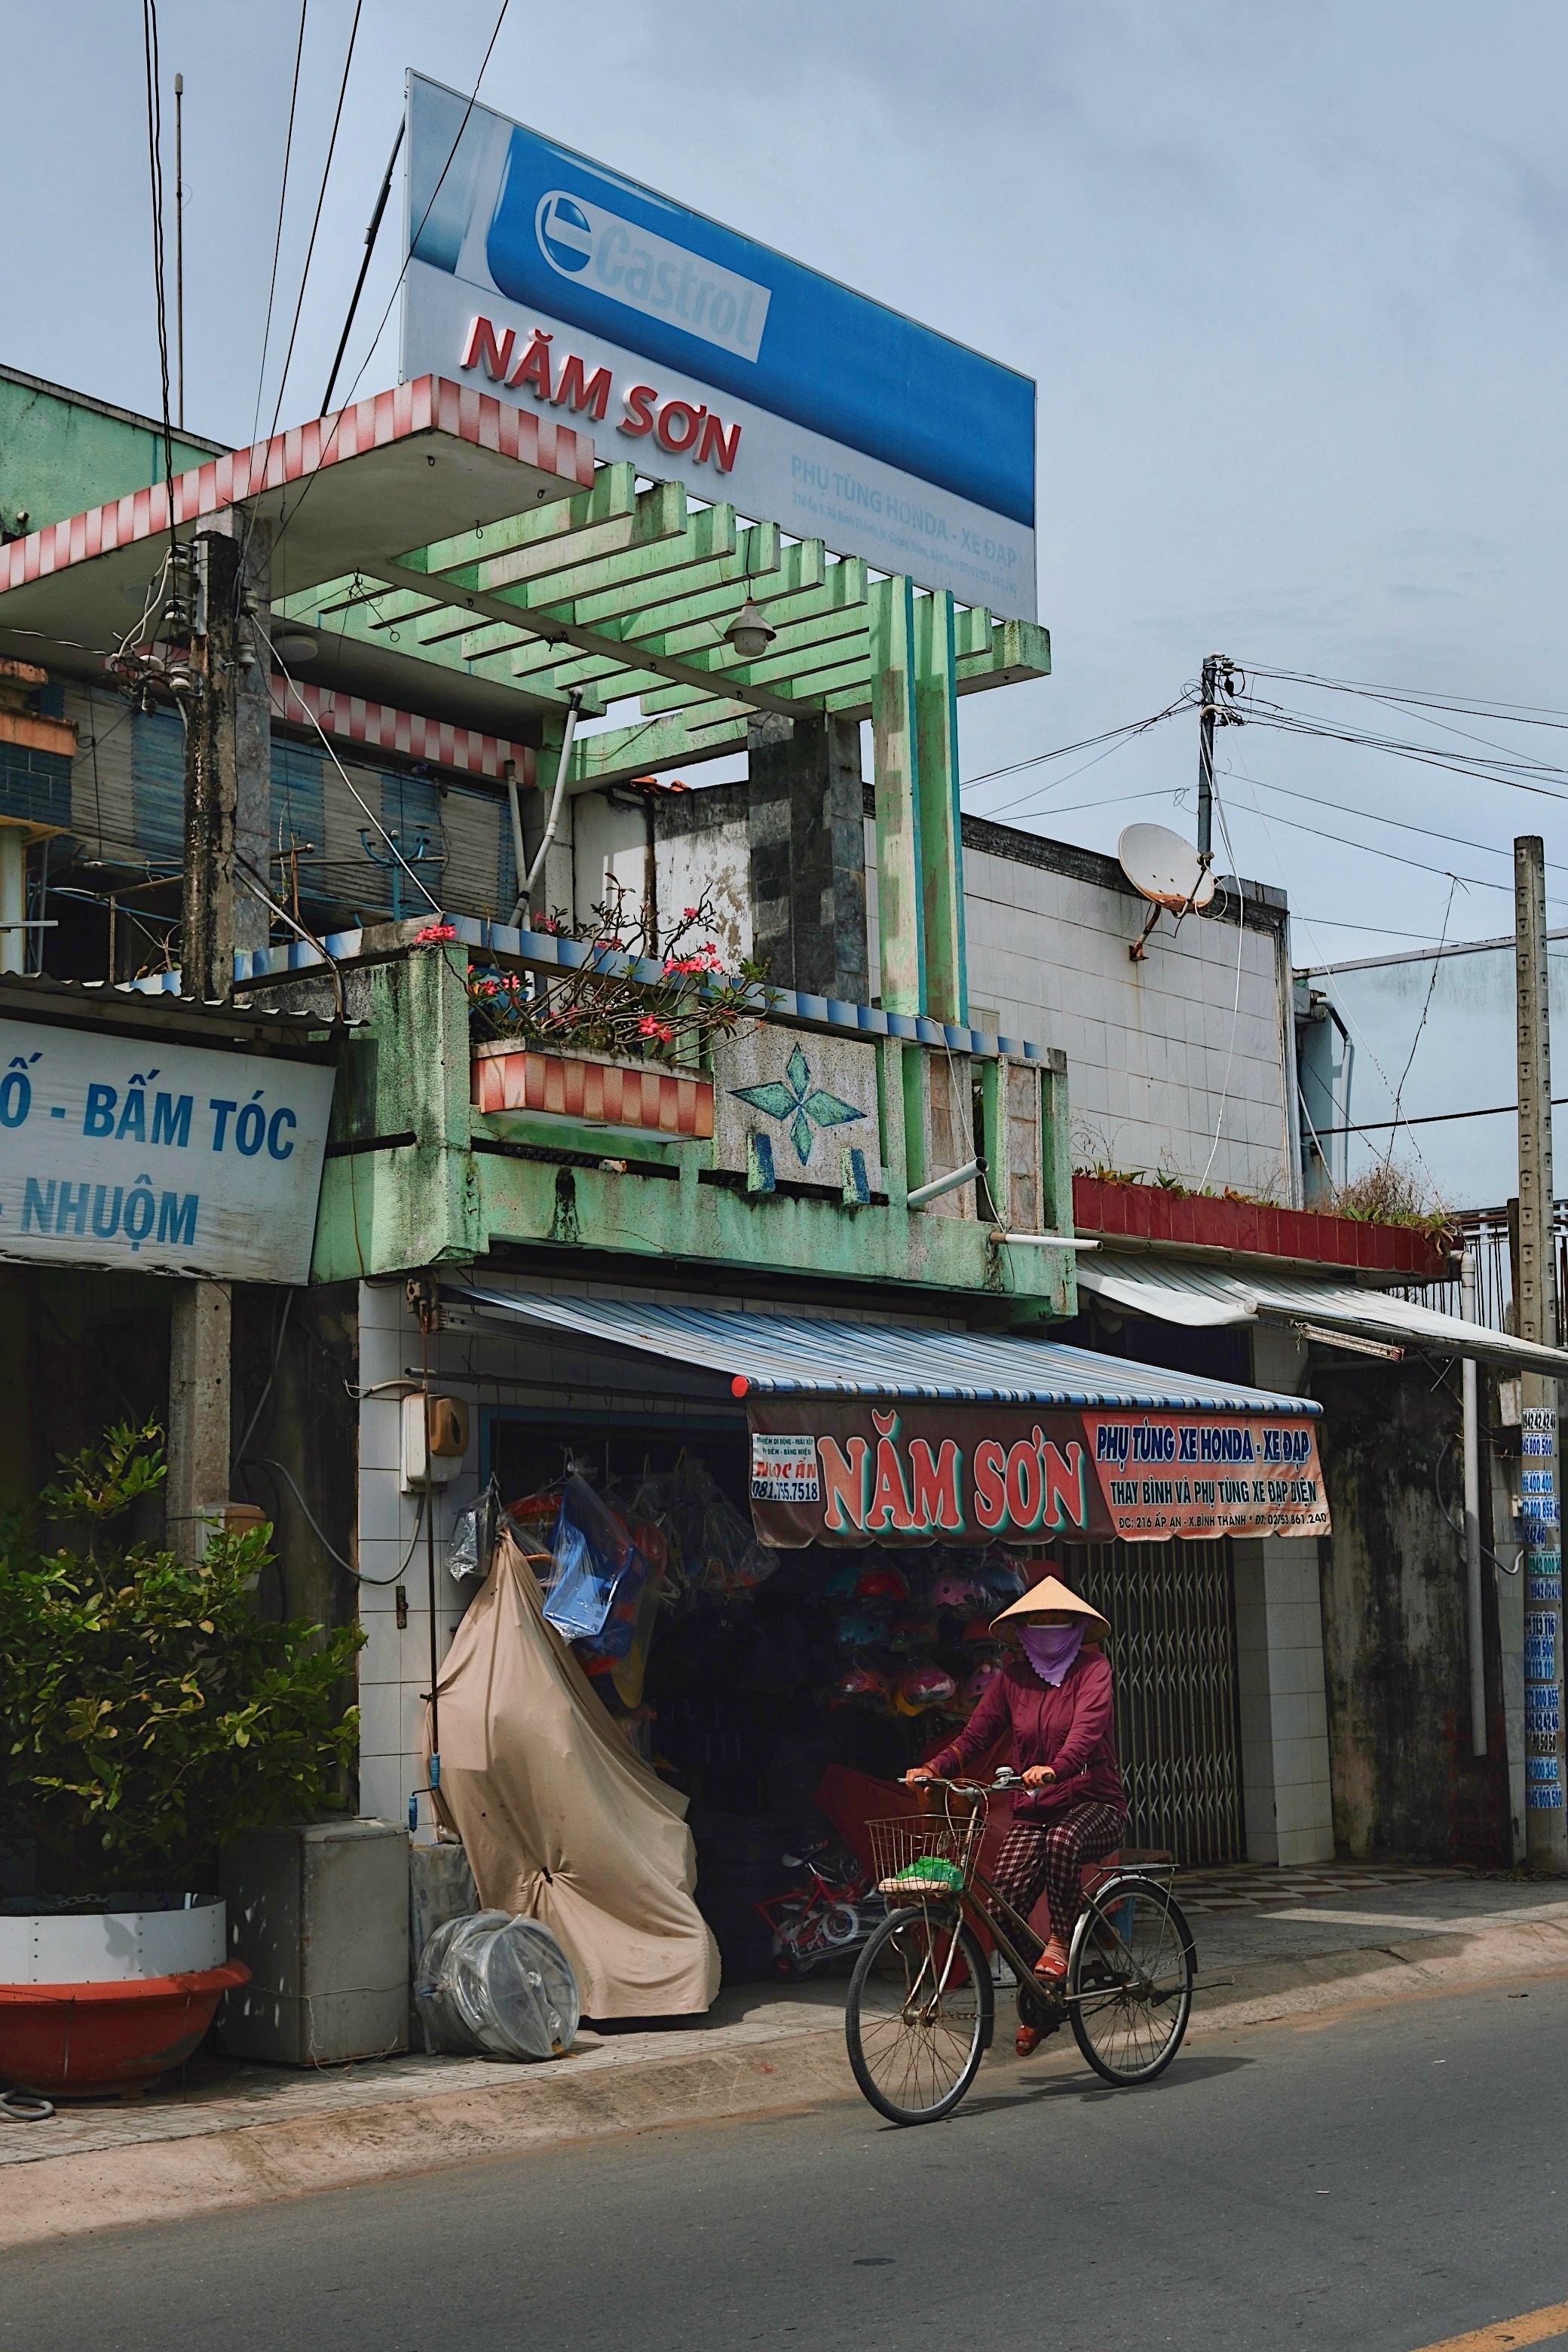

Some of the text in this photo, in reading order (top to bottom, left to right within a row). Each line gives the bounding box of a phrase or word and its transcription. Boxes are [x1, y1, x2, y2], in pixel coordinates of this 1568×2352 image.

[594, 225, 753, 346] Castrol
[461, 316, 743, 473] NĂM SƠN
[791, 455, 829, 496] PHỤ
[832, 473, 881, 514] TÙNG
[887, 495, 948, 541] HONDA
[960, 528, 980, 554] XE
[984, 537, 1016, 571] ĐẠP
[83, 1069, 194, 1147] BẤM
[210, 1090, 296, 1160] TÓC
[20, 1174, 199, 1251] NHUỘM
[818, 1408, 1087, 1536] NĂM SƠN
[1096, 1424, 1130, 1472] PHỤ
[1132, 1416, 1176, 1462] TÙNG
[1178, 1426, 1198, 1462] XE
[1200, 1427, 1254, 1462] HONDA
[1263, 1429, 1282, 1462] XE
[1282, 1430, 1311, 1472] ĐẠP
[1110, 1475, 1318, 1510] THAY BÌNH VÀ PHỤ TÙNG XE ĐẠP ĐIỆN
[1119, 1517, 1134, 1529] ĐC:
[1136, 1517, 1152, 1528] 216
[1154, 1511, 1167, 1527] ẤP
[1168, 1516, 1182, 1527] AN
[1188, 1513, 1215, 1527] X.BÌNH
[1217, 1511, 1246, 1526] THÀNH
[1255, 1514, 1266, 1525] ĐT:
[1267, 1512, 1327, 1524] 02753.861.240
